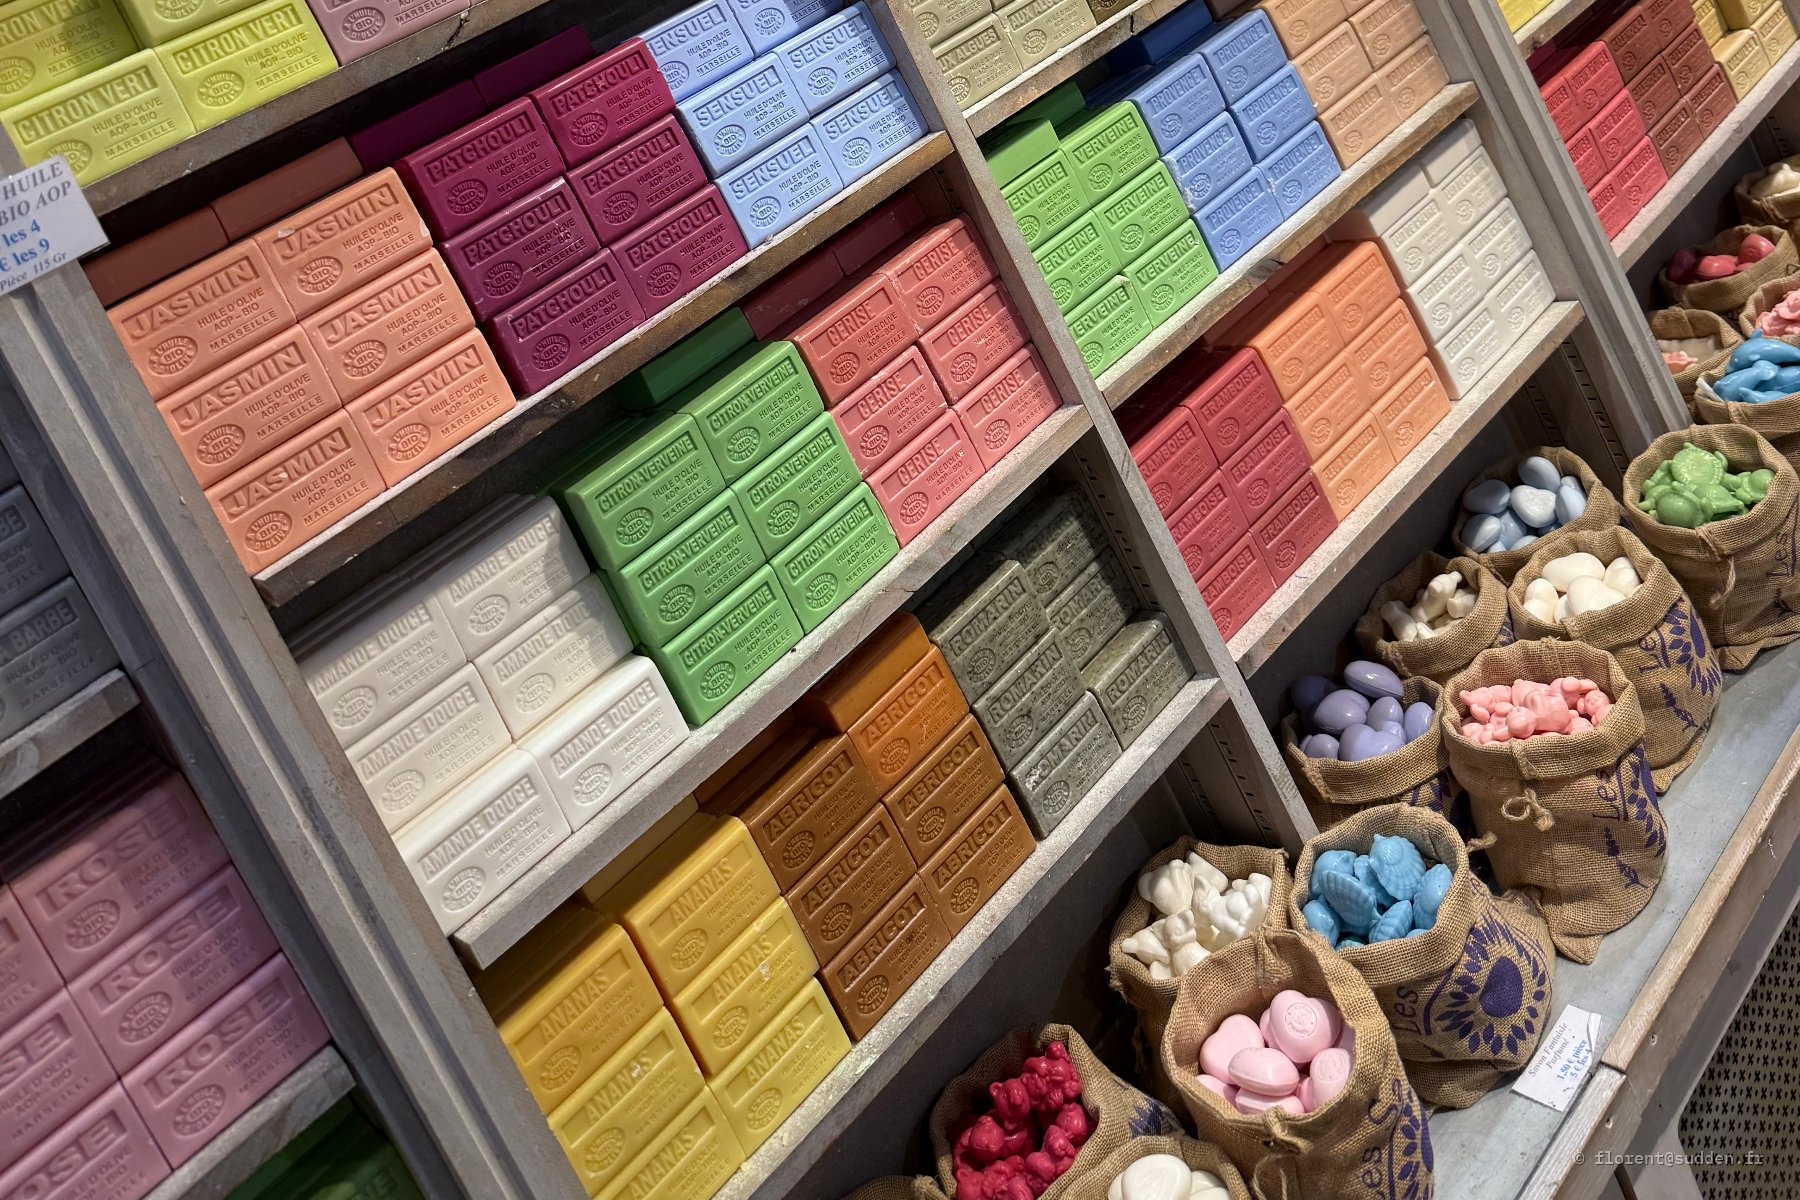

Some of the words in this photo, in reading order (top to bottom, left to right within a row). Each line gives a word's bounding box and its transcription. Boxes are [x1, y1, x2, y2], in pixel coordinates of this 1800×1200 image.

[174, 31, 241, 72] CITRON
[246, 6, 300, 42] VERT
[698, 73, 781, 126] SENSUEL
[429, 119, 530, 180] PATCHOULI
[1074, 115, 1137, 162] VERVEINE
[733, 147, 812, 200] SENSUEL
[1105, 174, 1167, 223] VERVEINE
[0, 200, 30, 226] BIO
[36, 180, 72, 210] AOP
[279, 188, 394, 257] JASMIN
[2, 228, 27, 247] les
[31, 219, 40, 233] 4
[12, 247, 37, 267] les
[40, 237, 50, 254] 9
[33, 259, 51, 274] 115
[53, 252, 67, 264] Gr
[132, 264, 252, 339] JASMIN
[514, 274, 611, 338] PATCHOULI
[828, 301, 875, 350] CERISE
[1202, 365, 1259, 420] FRAMBOISE
[229, 432, 346, 515] JASMIN
[292, 479, 322, 502] HUILE
[320, 458, 357, 485] D'OLIVE
[308, 488, 328, 506] AOP
[336, 473, 352, 489] BIO
[897, 441, 943, 489] CERISE
[304, 480, 368, 525] MARSEILLE
[1260, 486, 1315, 543] FRAMBOISE
[259, 524, 278, 539] BIO
[735, 631, 755, 653] HUILE
[744, 629, 792, 672] MARSEILLE
[554, 732, 605, 774] AMANDE
[608, 684, 655, 729] DOUCE
[764, 758, 852, 839] ABRICOT
[422, 828, 480, 876] AMANDE
[483, 780, 536, 828] DOUCE
[669, 858, 736, 924] ANANAS
[804, 828, 890, 912] ABRICOT
[1393, 986, 1422, 1036] Les
[150, 984, 285, 1102] ROSE
[1528, 1054, 1547, 1078] Savon
